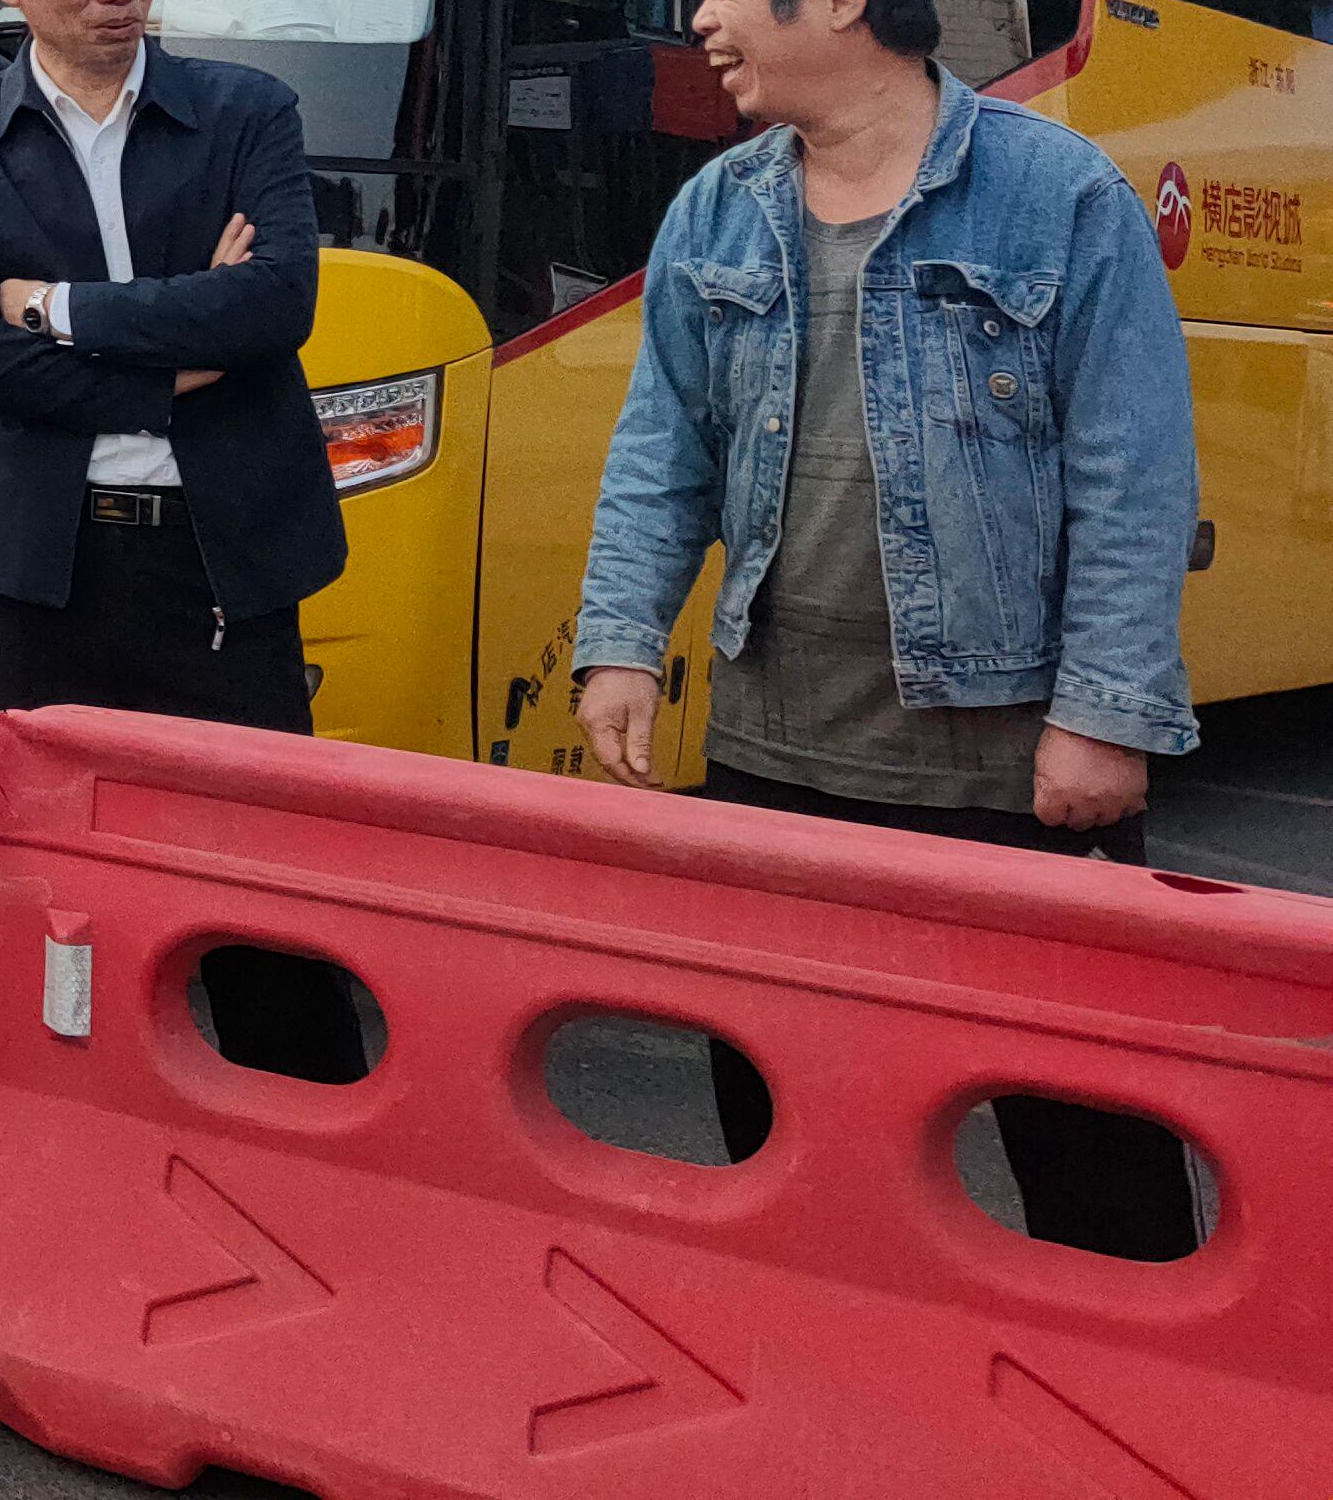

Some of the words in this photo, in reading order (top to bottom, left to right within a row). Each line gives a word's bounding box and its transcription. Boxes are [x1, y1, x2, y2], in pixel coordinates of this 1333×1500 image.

[1201, 179, 1303, 246] 横店影视城
